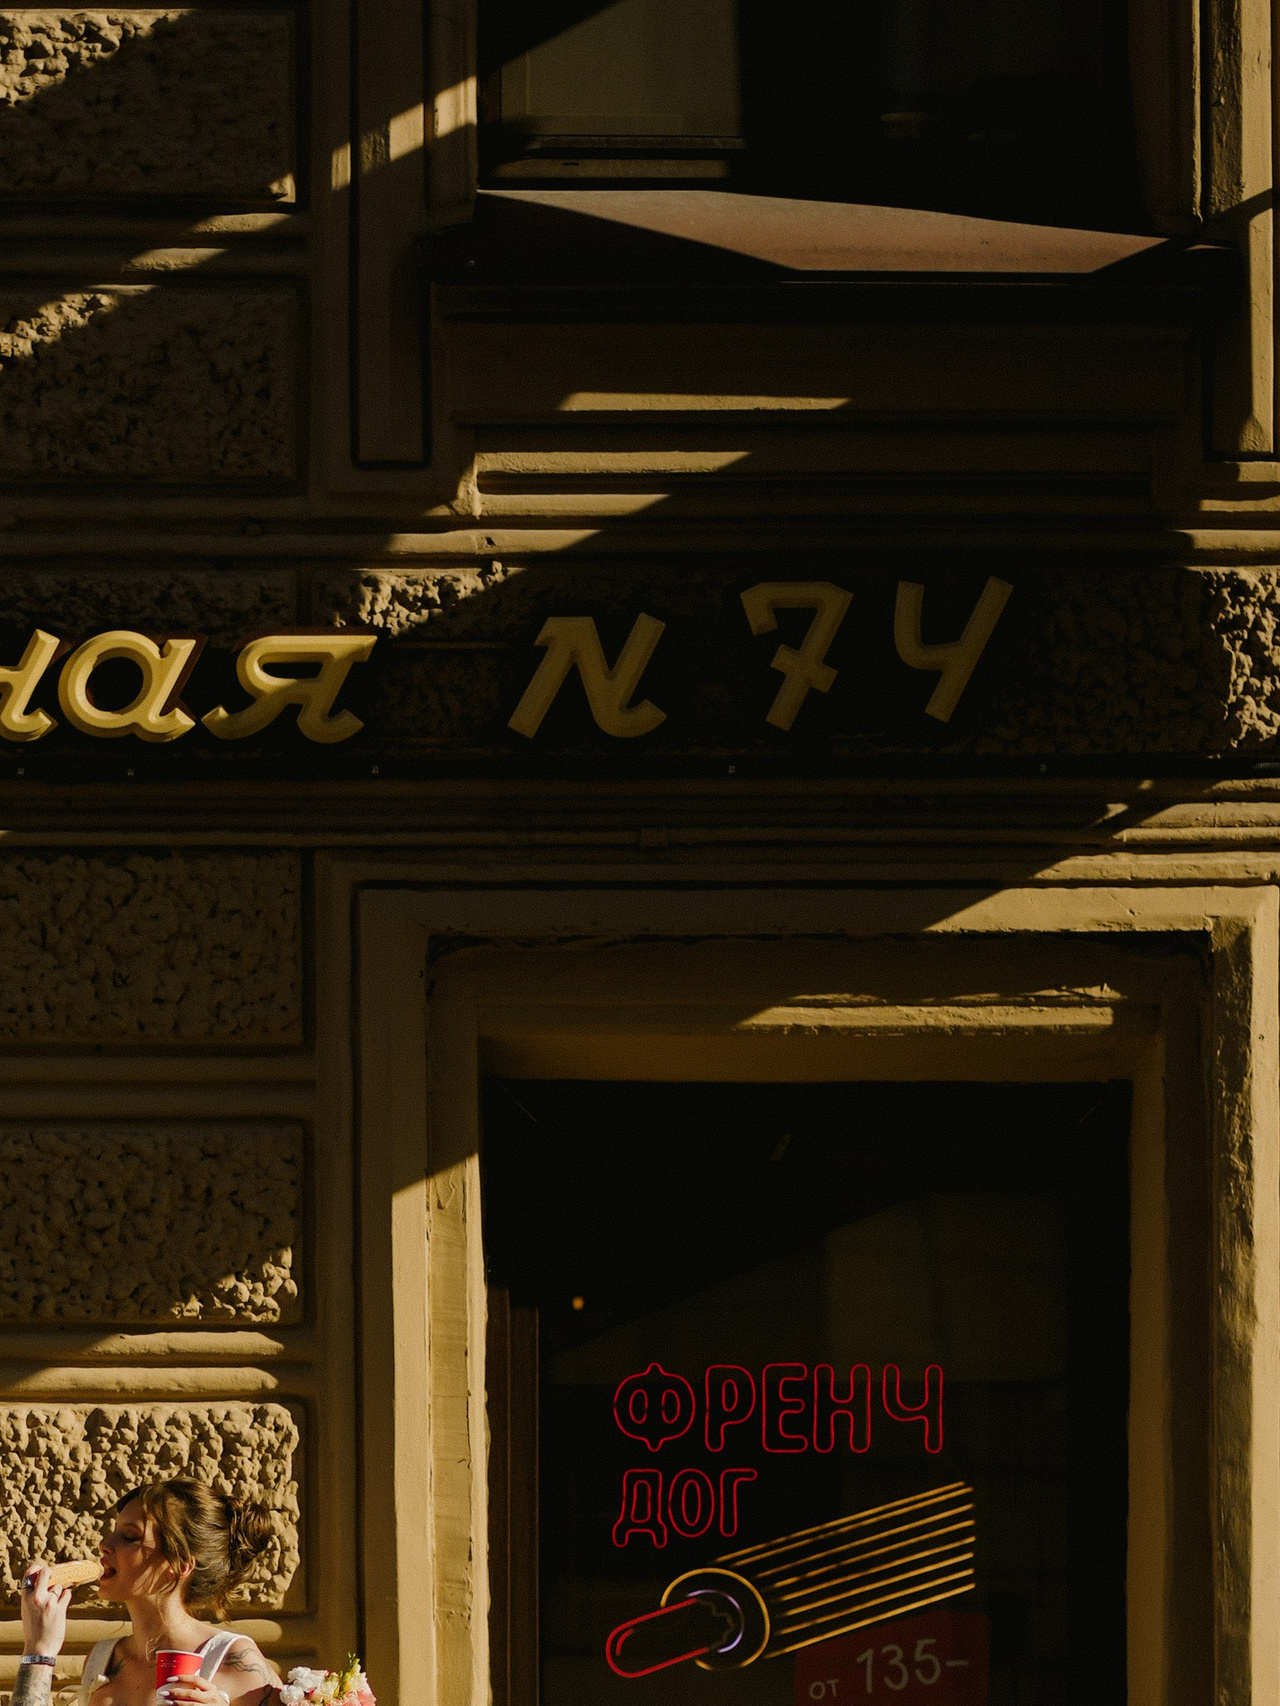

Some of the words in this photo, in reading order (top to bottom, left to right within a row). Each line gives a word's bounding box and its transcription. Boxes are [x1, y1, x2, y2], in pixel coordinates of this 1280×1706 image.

[507, 612, 667, 739] N
[739, 575, 1015, 732] 74
[613, 1362, 943, 1453] ФРЕНЧ
[612, 1468, 758, 1548] ДОГ
